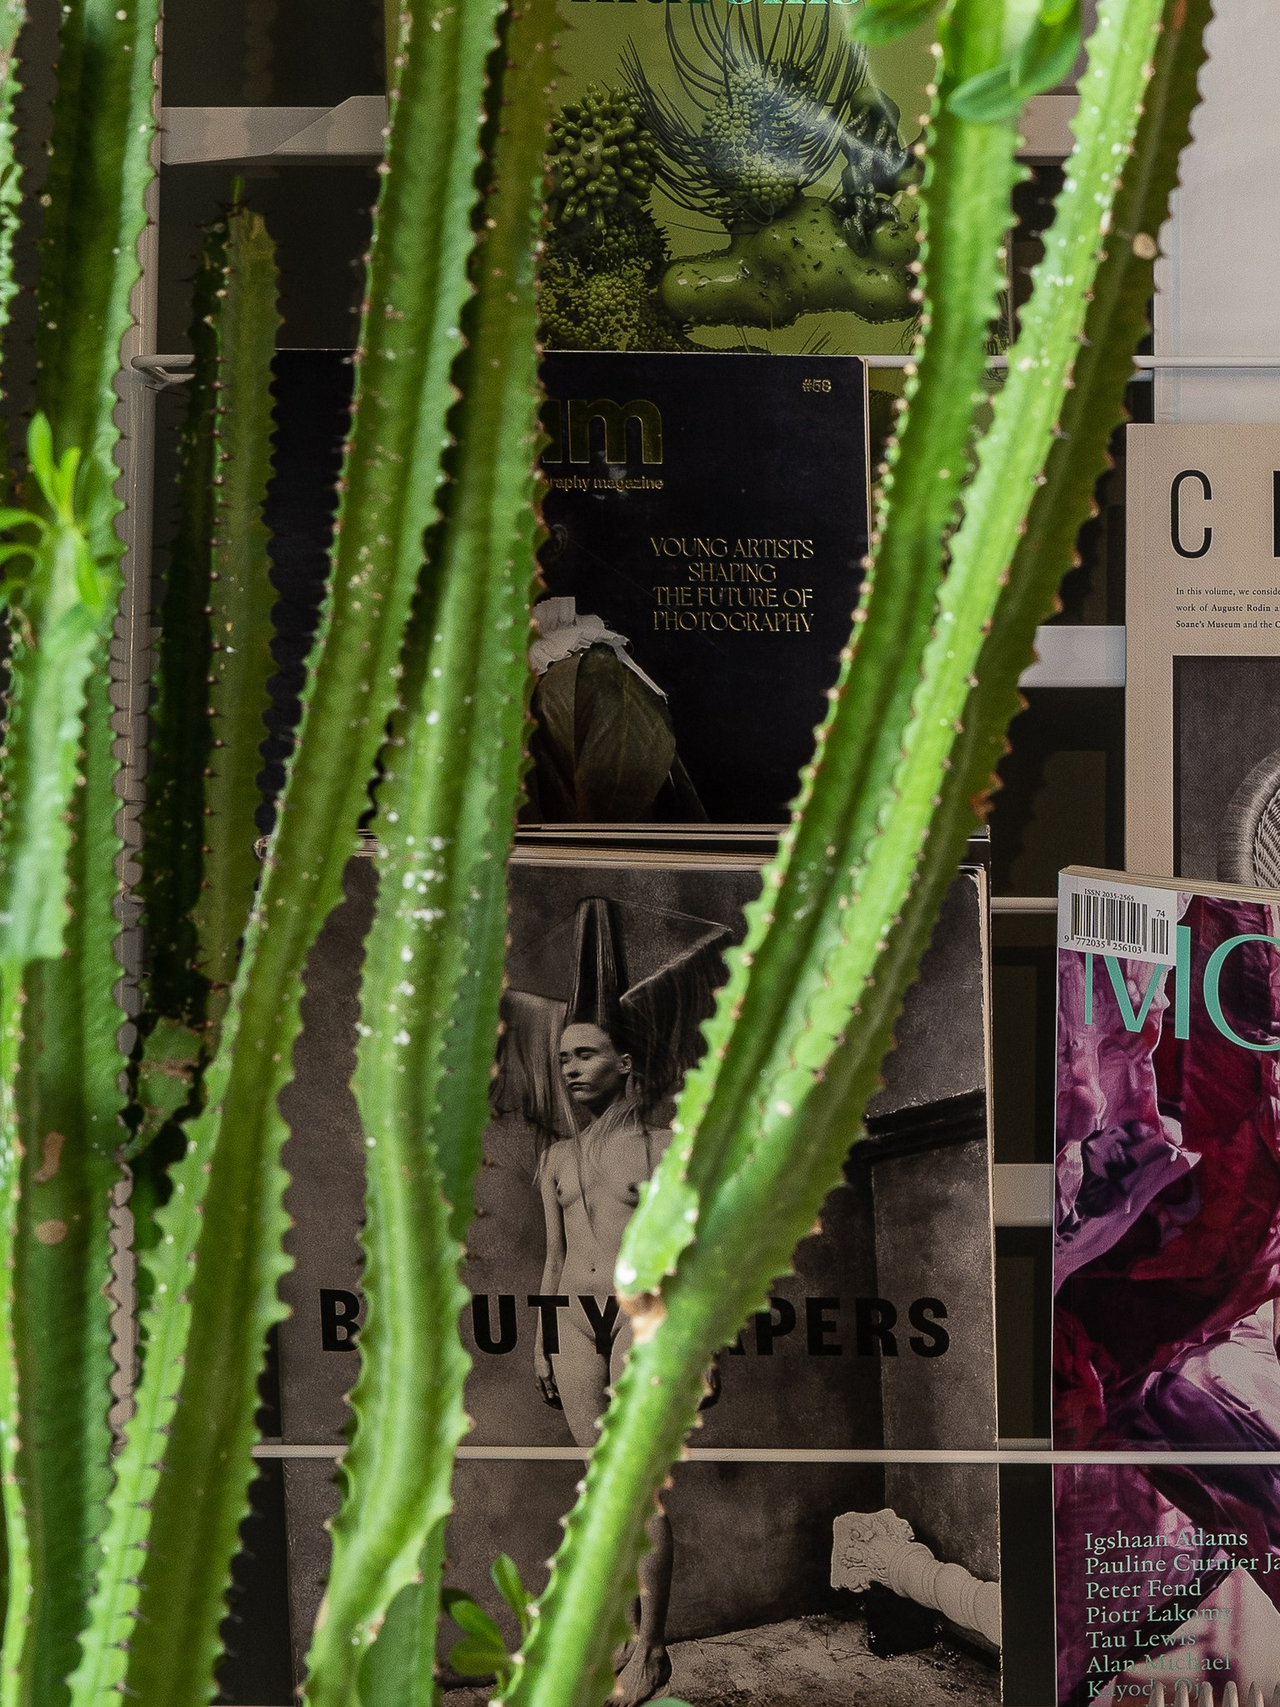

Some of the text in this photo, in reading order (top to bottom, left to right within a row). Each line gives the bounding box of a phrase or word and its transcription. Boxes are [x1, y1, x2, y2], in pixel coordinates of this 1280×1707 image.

[593, 476, 664, 492] magazine
[650, 537, 814, 559] YOUNG ARTISTS
[688, 562, 777, 583] SHAPING
[652, 586, 813, 608] THE FUTURE OF
[1176, 587, 1184, 595] In
[1187, 587, 1201, 595] this
[1204, 587, 1236, 597] volume,
[653, 611, 815, 632] PHOTOGRAPHY
[1084, 888, 1135, 902] ISSN 2035-2565
[1155, 909, 1166, 918] 74
[319, 1288, 951, 1358] BUTY PERS
[1085, 1529, 1248, 1554] Igshaan Adams
[1085, 1553, 1167, 1576] Pauline
[1173, 1553, 1259, 1573] Curnier
[1085, 1579, 1202, 1600] Peter Fend
[1086, 1603, 1233, 1629] Piotr Łakomy
[1086, 1631, 1197, 1649] Tau Lewis
[1086, 1653, 1231, 1673] Alan Michael
